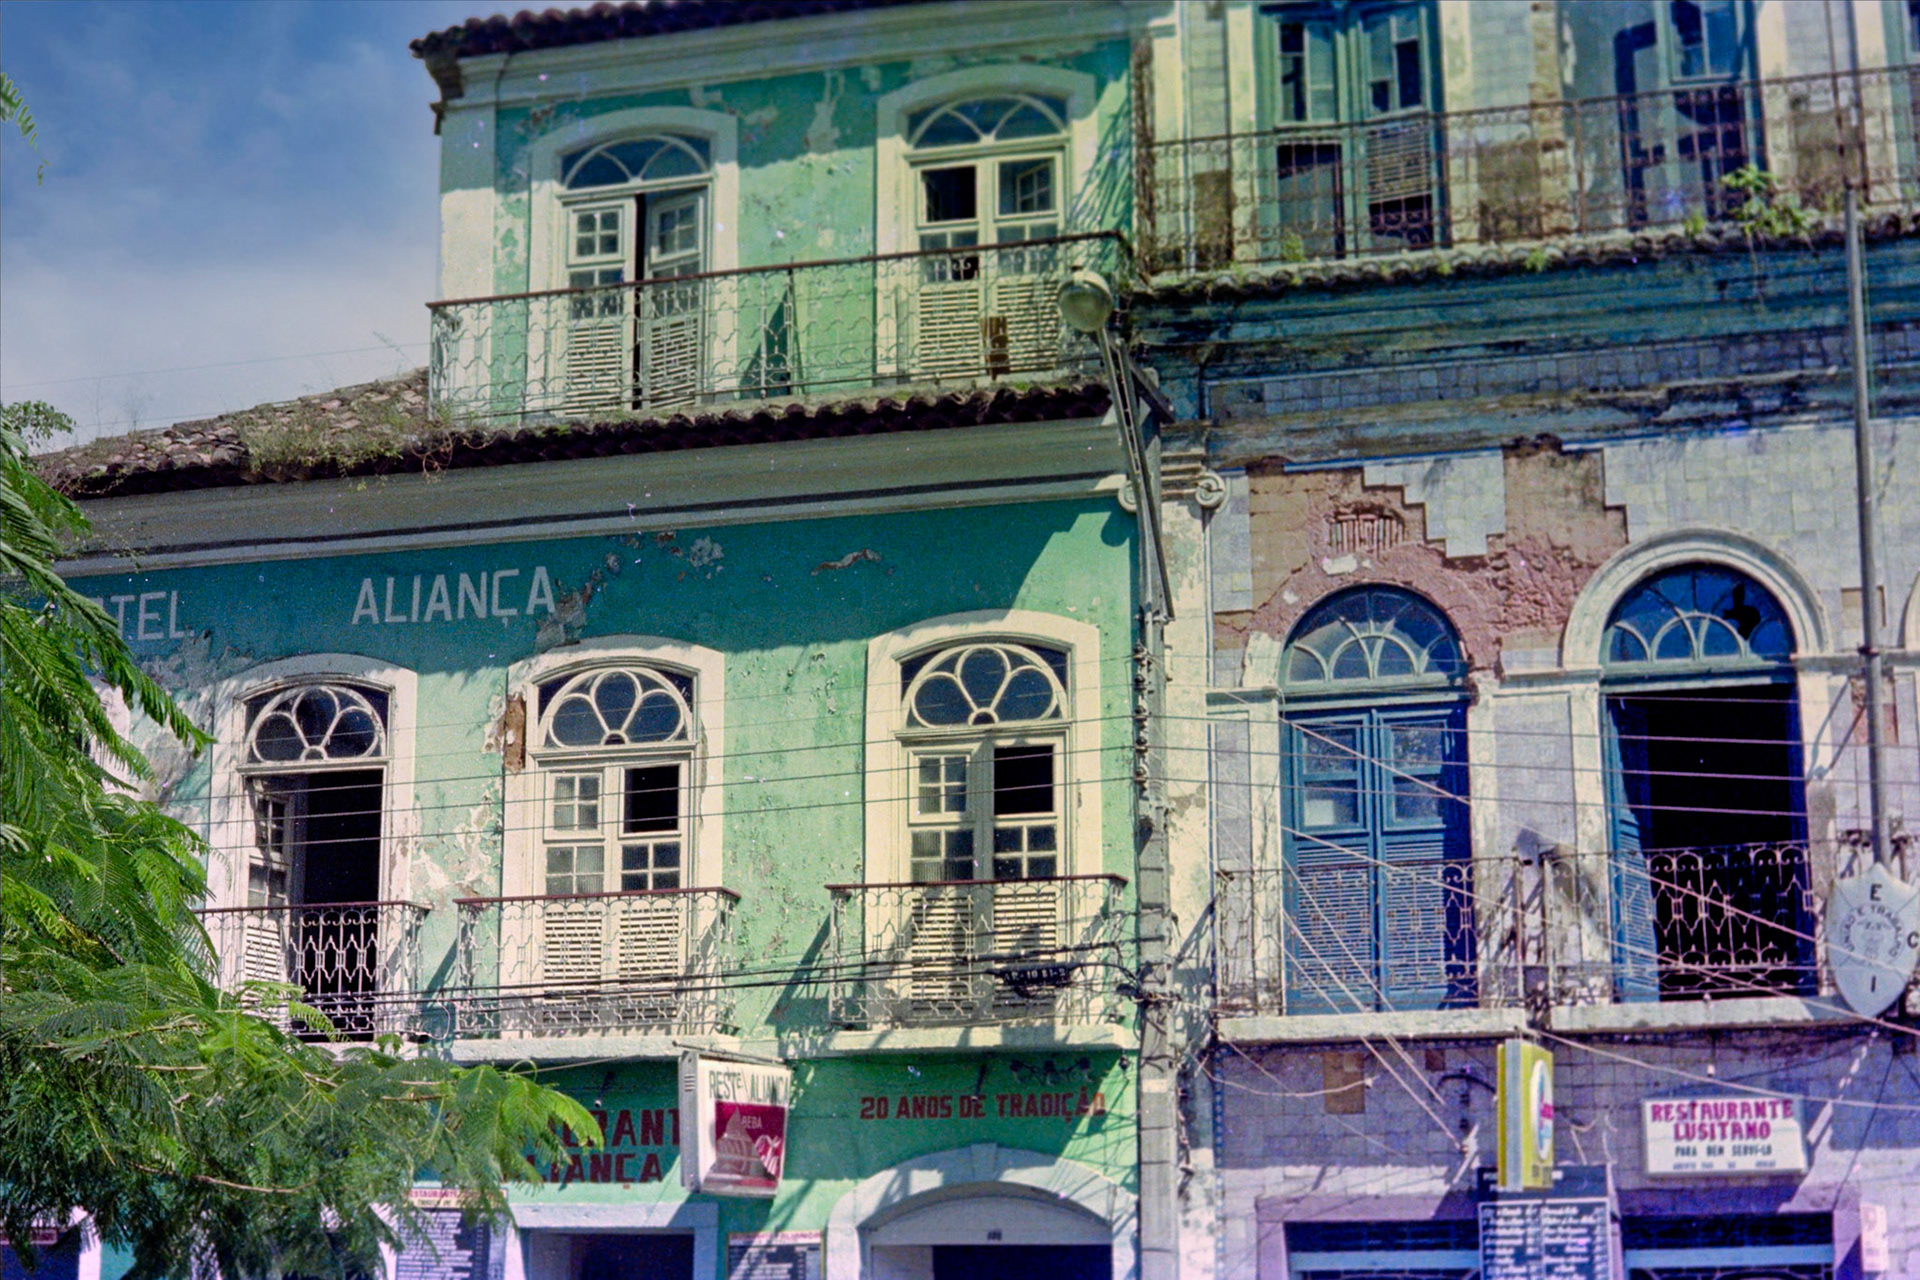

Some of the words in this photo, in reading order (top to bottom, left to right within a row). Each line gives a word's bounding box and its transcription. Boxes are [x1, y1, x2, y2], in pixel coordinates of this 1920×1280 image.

[88, 590, 194, 642] TEL
[351, 565, 556, 629] ALIANÇA
[1869, 883, 1882, 901] E
[1907, 931, 1920, 949] C
[860, 1096, 888, 1120] 20
[895, 1095, 952, 1120] ANOS
[958, 1094, 986, 1119] DE
[995, 1085, 1107, 1124] TRADIÇÃO
[1651, 1099, 1794, 1122] RESTAURANTE
[1673, 1120, 1771, 1142] LUSITANO
